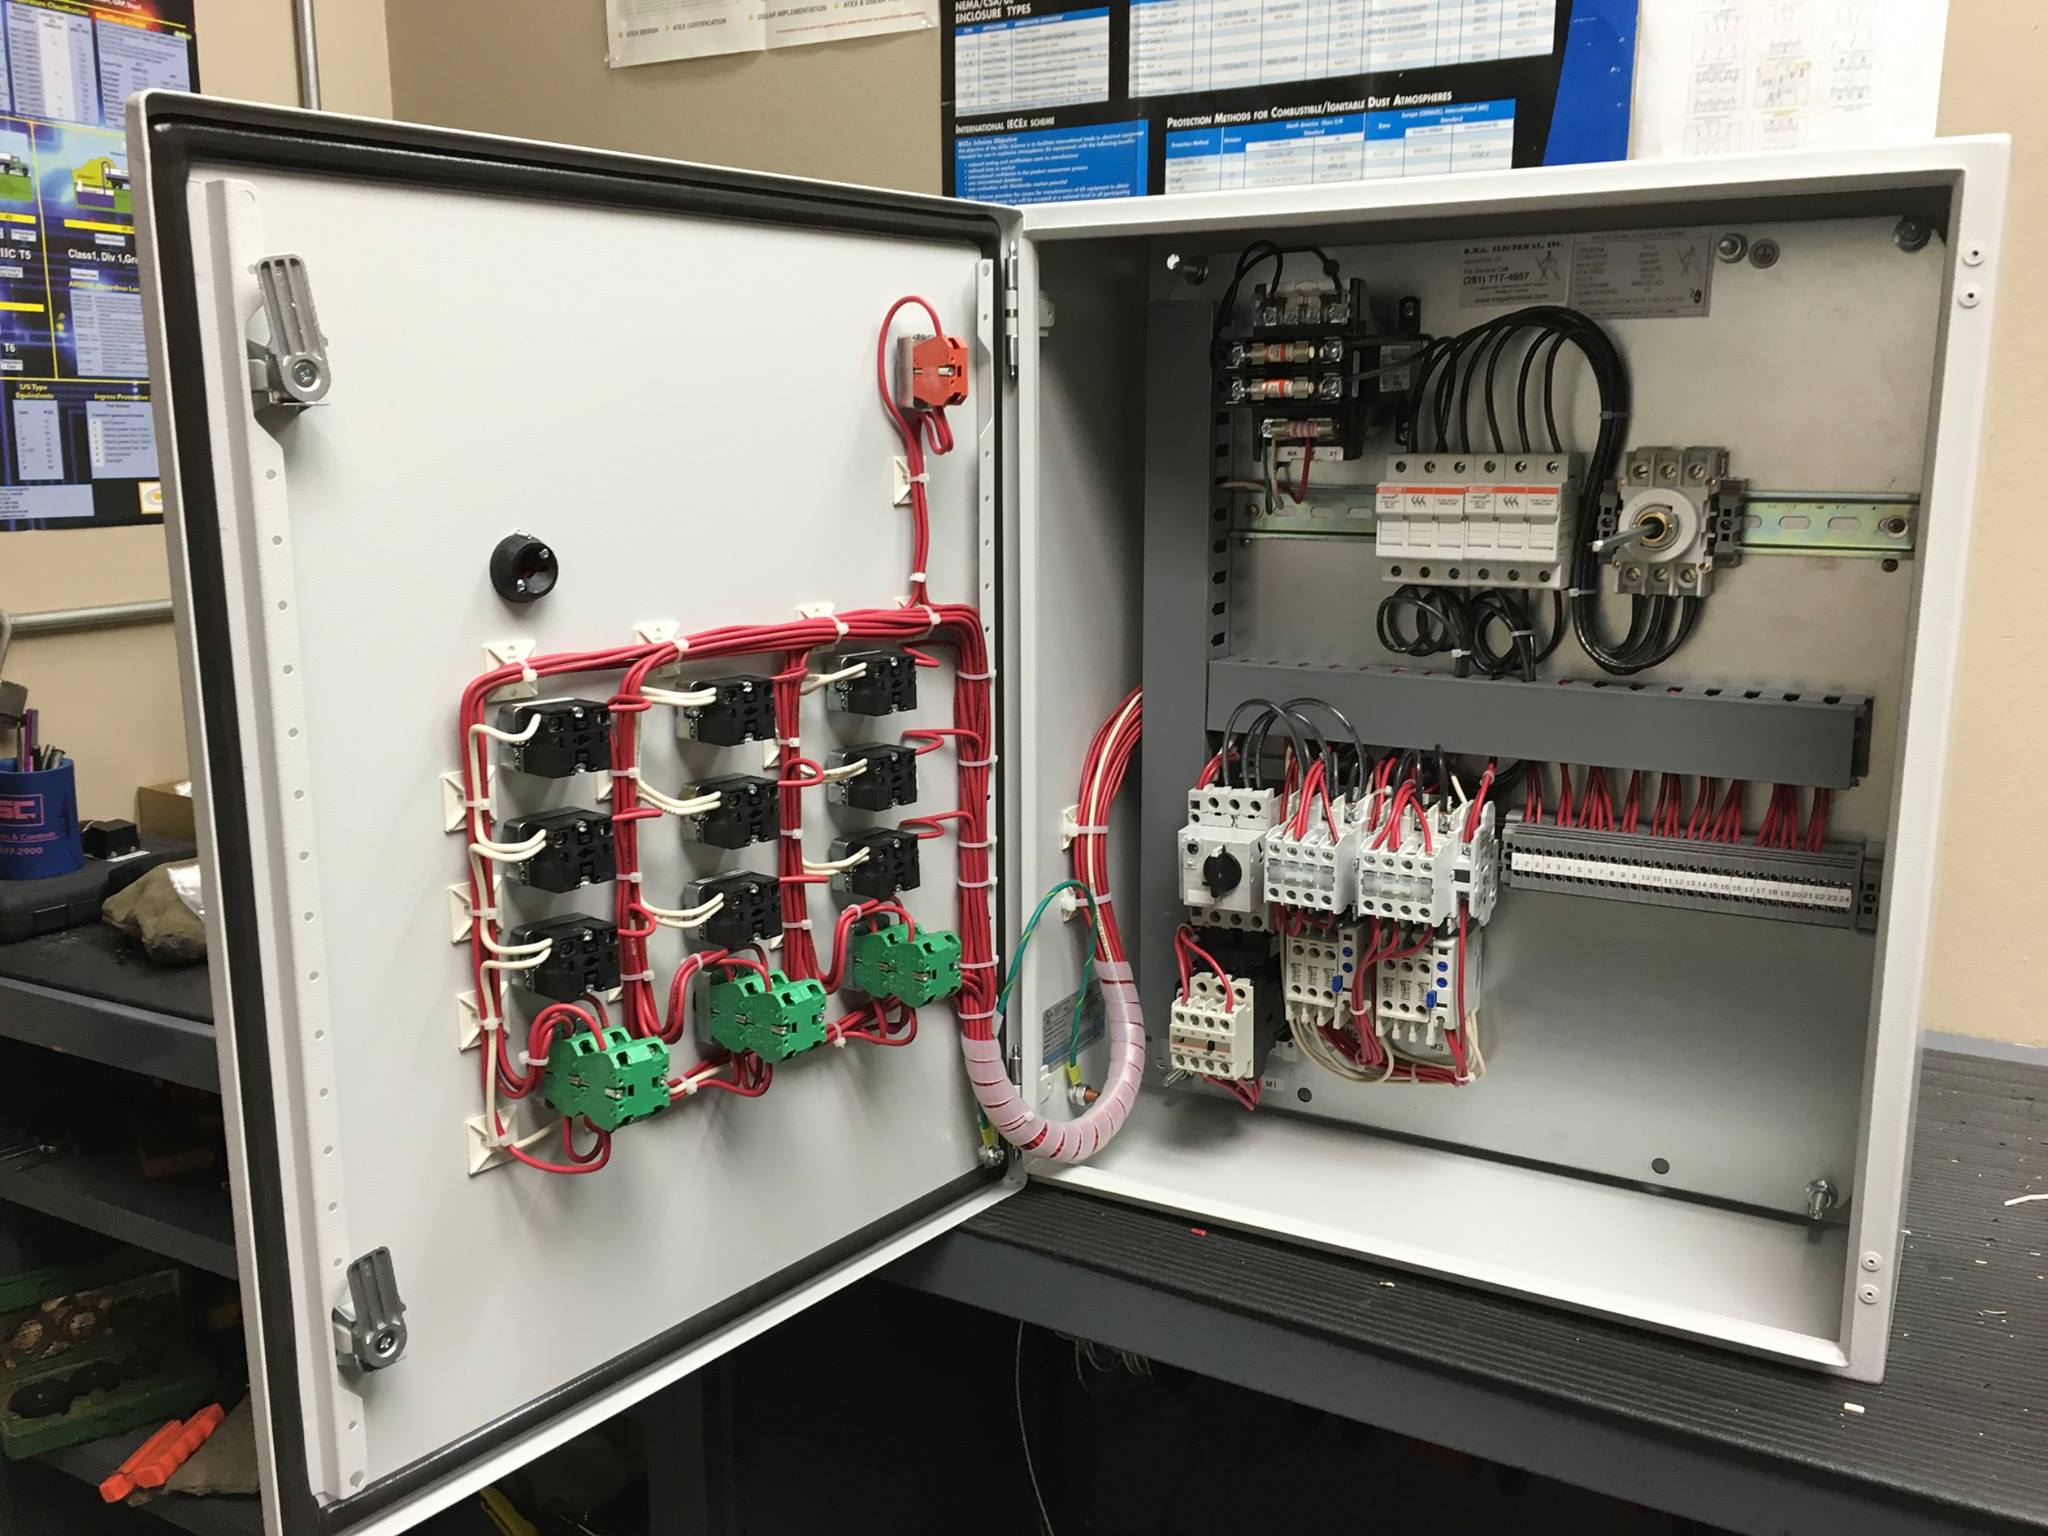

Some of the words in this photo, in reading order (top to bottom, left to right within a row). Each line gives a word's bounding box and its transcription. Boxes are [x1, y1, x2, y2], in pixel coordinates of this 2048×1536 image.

[955, 7, 1002, 24] ENCLOSURE
[1007, 3, 1031, 17] TYPES
[1393, 91, 1452, 107] ATMOSPHERES
[18, 249, 31, 260] T5
[100, 252, 116, 262] Div
[1464, 275, 1486, 287] (281)
[3, 343, 16, 353] T6
[1430, 1043, 1444, 1052] M3
[1266, 1080, 1277, 1089] M1
